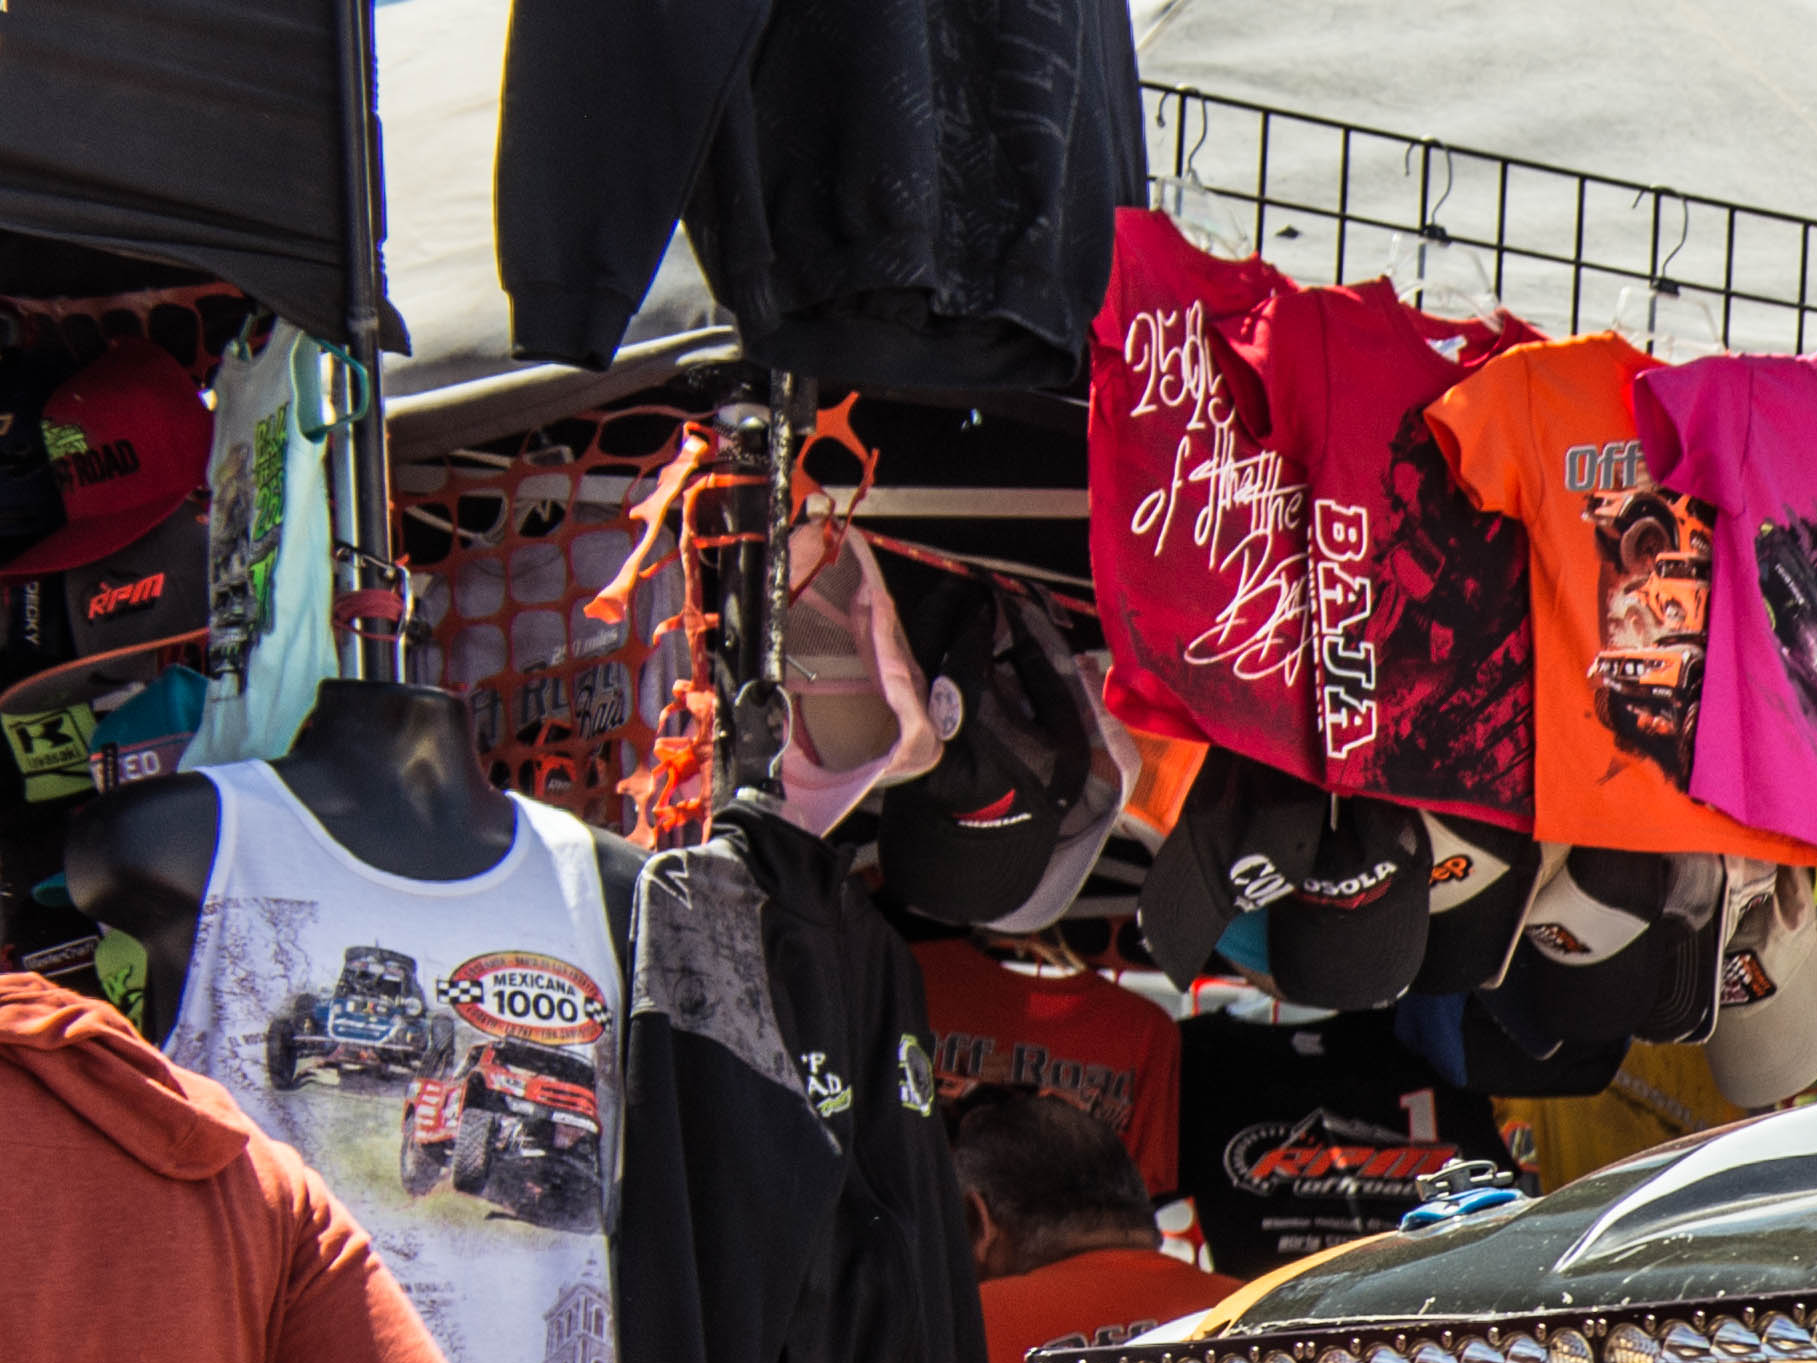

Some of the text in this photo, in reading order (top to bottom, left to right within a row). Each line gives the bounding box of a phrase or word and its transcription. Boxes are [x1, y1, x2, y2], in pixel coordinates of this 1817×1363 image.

[87, 572, 165, 620] RPM
[1314, 499, 1378, 759] BAJA
[491, 989, 580, 1023] 1000
[492, 972, 577, 998] MEXICANA
[1399, 1087, 1439, 1144] 1
